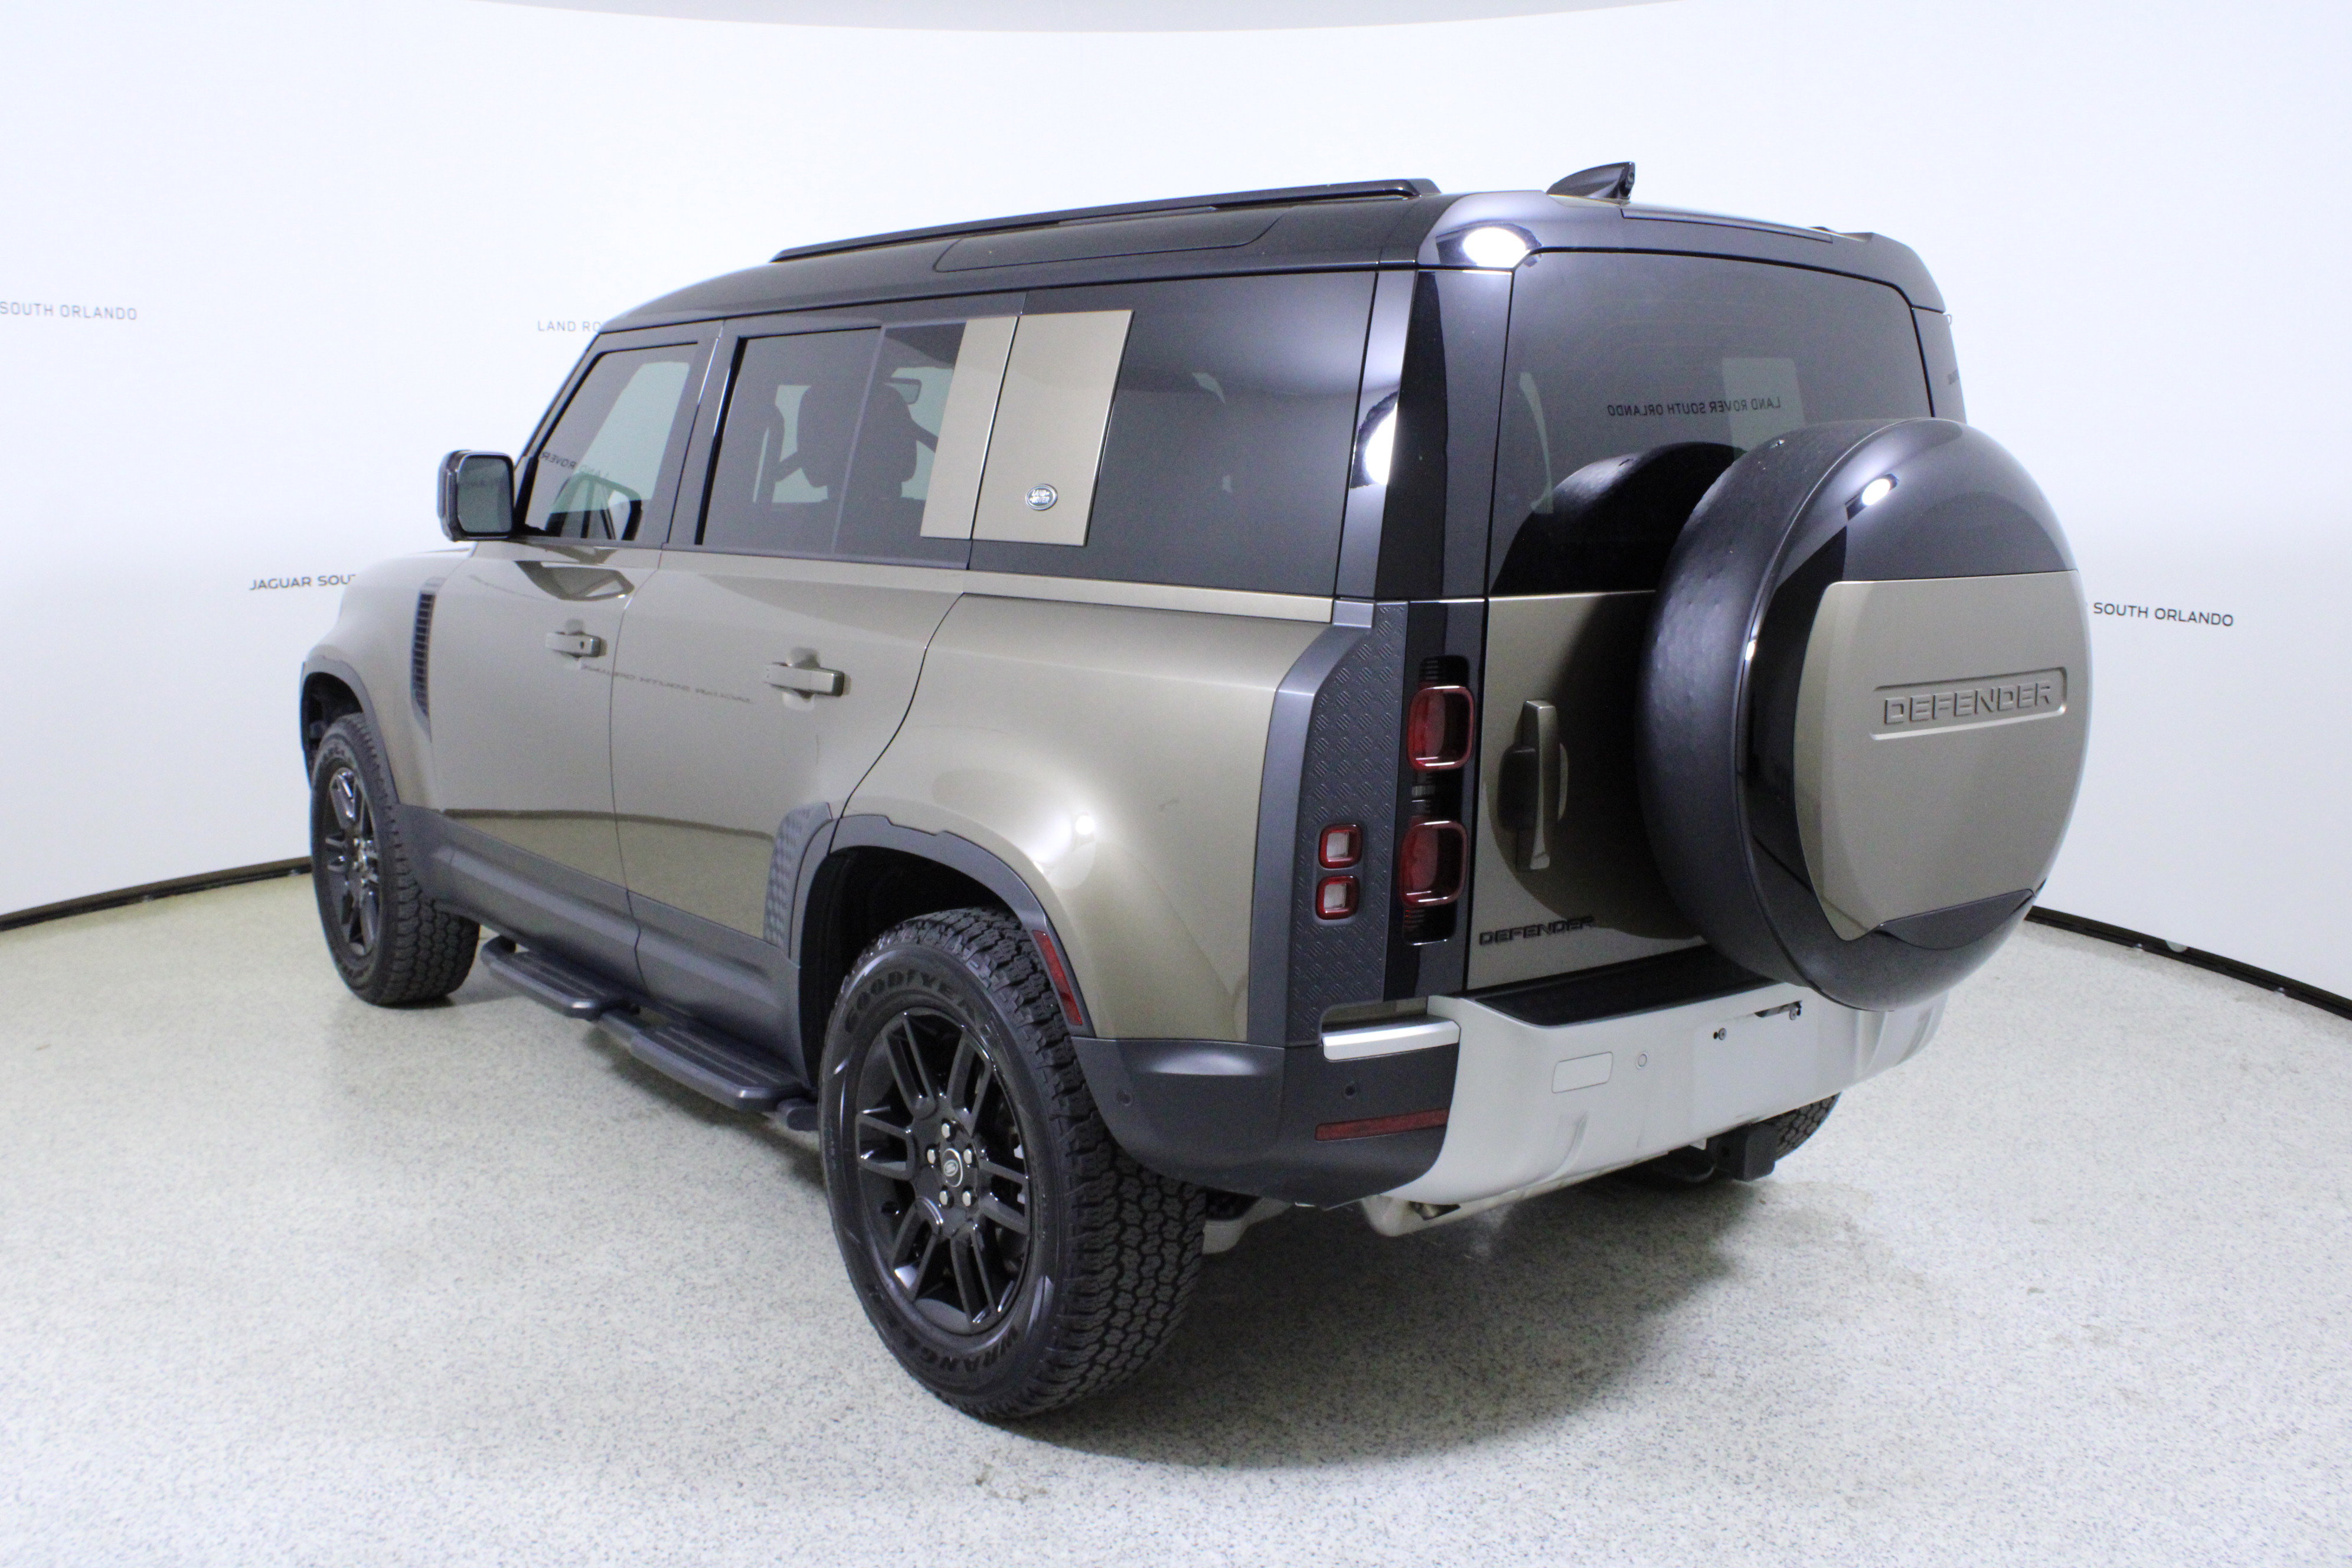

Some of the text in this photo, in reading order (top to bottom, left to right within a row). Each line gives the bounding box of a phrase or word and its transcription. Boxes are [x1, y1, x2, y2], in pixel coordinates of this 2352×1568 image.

[0, 301, 138, 321] SOUTH ORLANDO
[537, 320, 576, 332] LAND
[249, 576, 312, 591] JAGUAR
[2093, 602, 2234, 626] SOUTH ORLANDO
[1883, 680, 2052, 726] DEFENDER
[1479, 916, 1595, 946] DEFENDER
